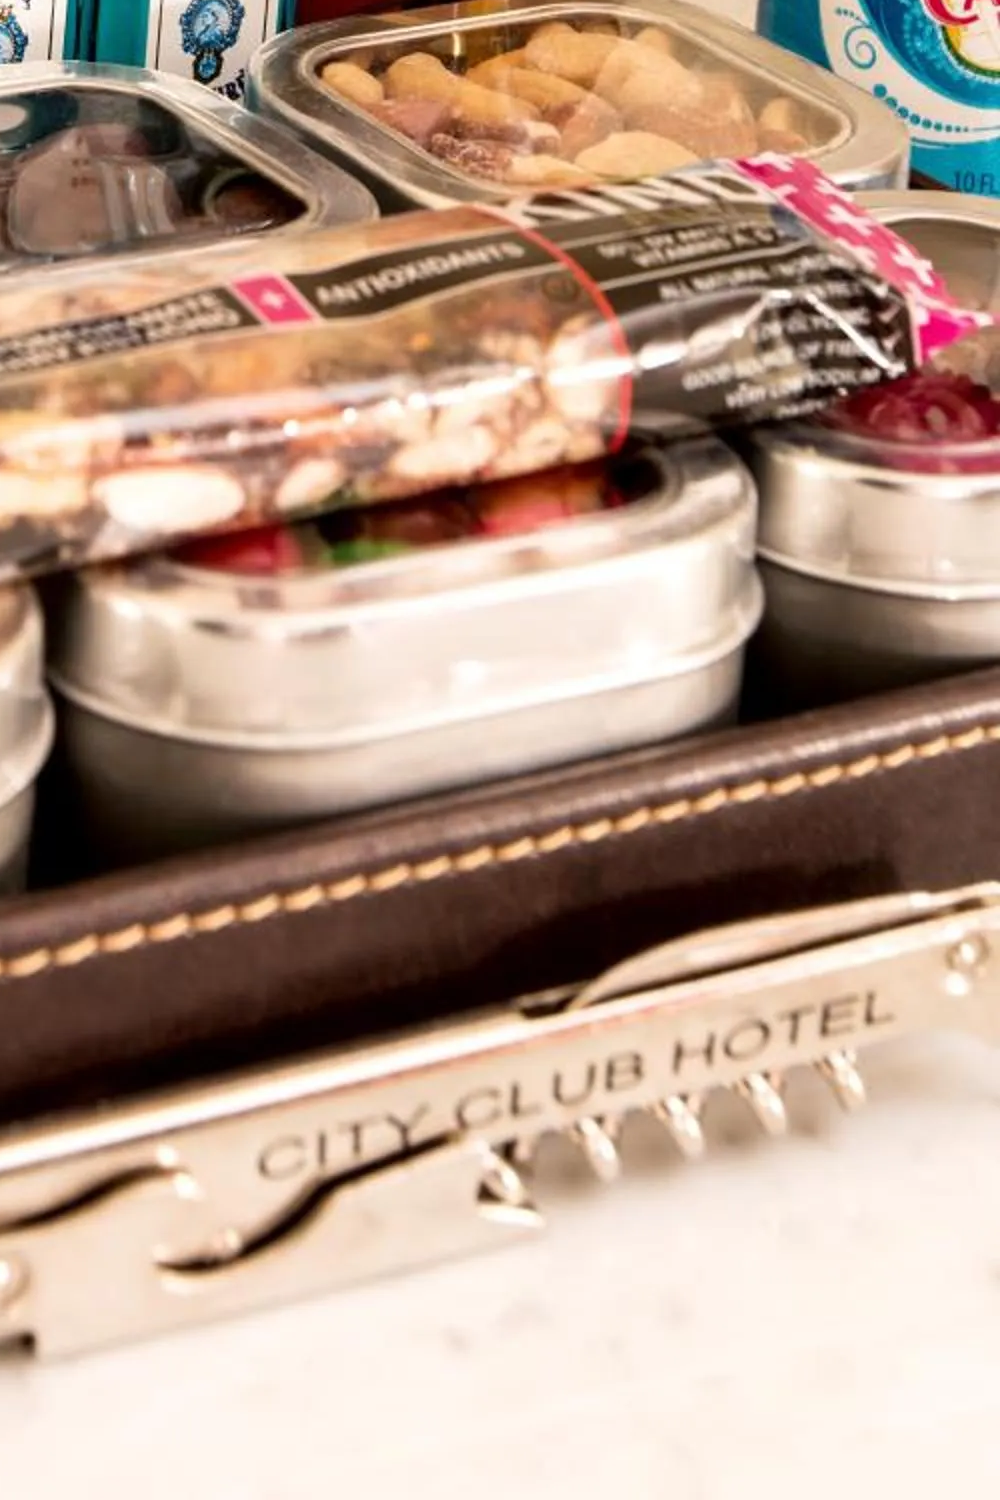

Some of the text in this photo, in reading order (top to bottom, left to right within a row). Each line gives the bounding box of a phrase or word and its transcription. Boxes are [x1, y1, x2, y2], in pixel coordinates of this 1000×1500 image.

[955, 170, 976, 192] 10
[314, 241, 526, 306] ANTIOXIDANTS
[257, 990, 896, 1181] CITY CLUB HOTEL
